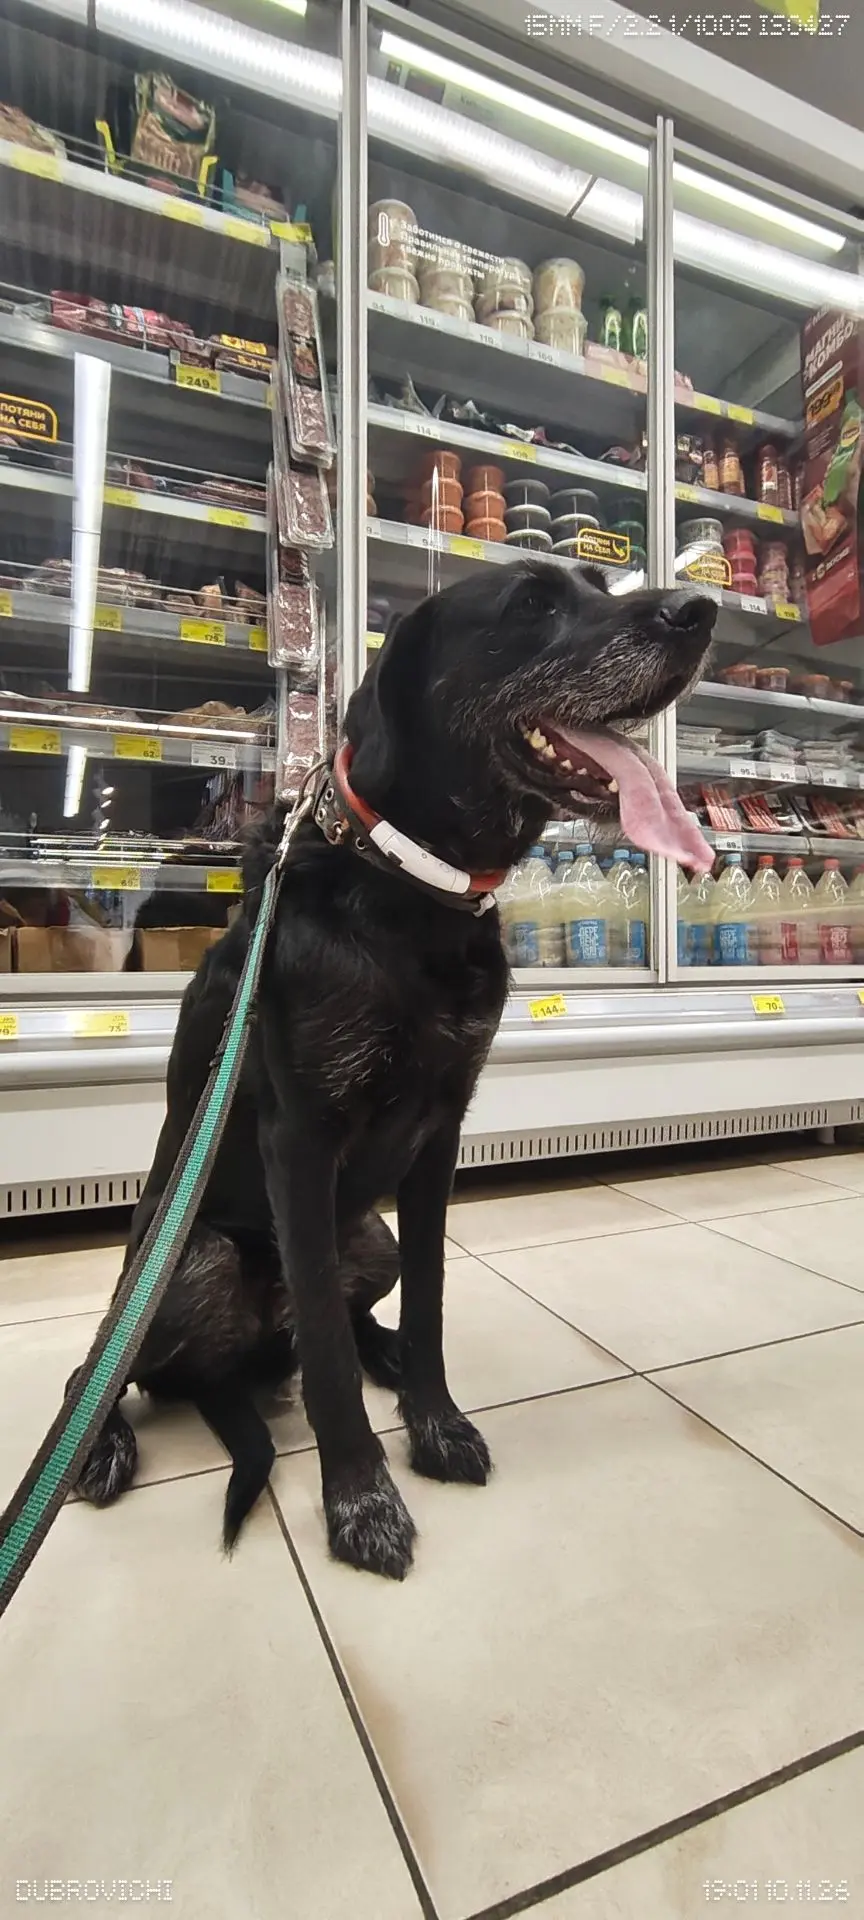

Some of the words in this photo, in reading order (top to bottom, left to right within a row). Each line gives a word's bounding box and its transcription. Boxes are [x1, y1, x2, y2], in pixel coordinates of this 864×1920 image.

[400, 219, 452, 246] Заботимся
[454, 241, 461, 249] о
[186, 376, 210, 389] 249
[1, 403, 46, 421] ПОТЯНИ
[0, 413, 16, 425] НА
[18, 418, 46, 431] СЕБЯ
[143, 750, 155, 758] 62
[210, 755, 226, 766] 39
[541, 1004, 559, 1017] 144
[766, 1002, 778, 1011] 70
